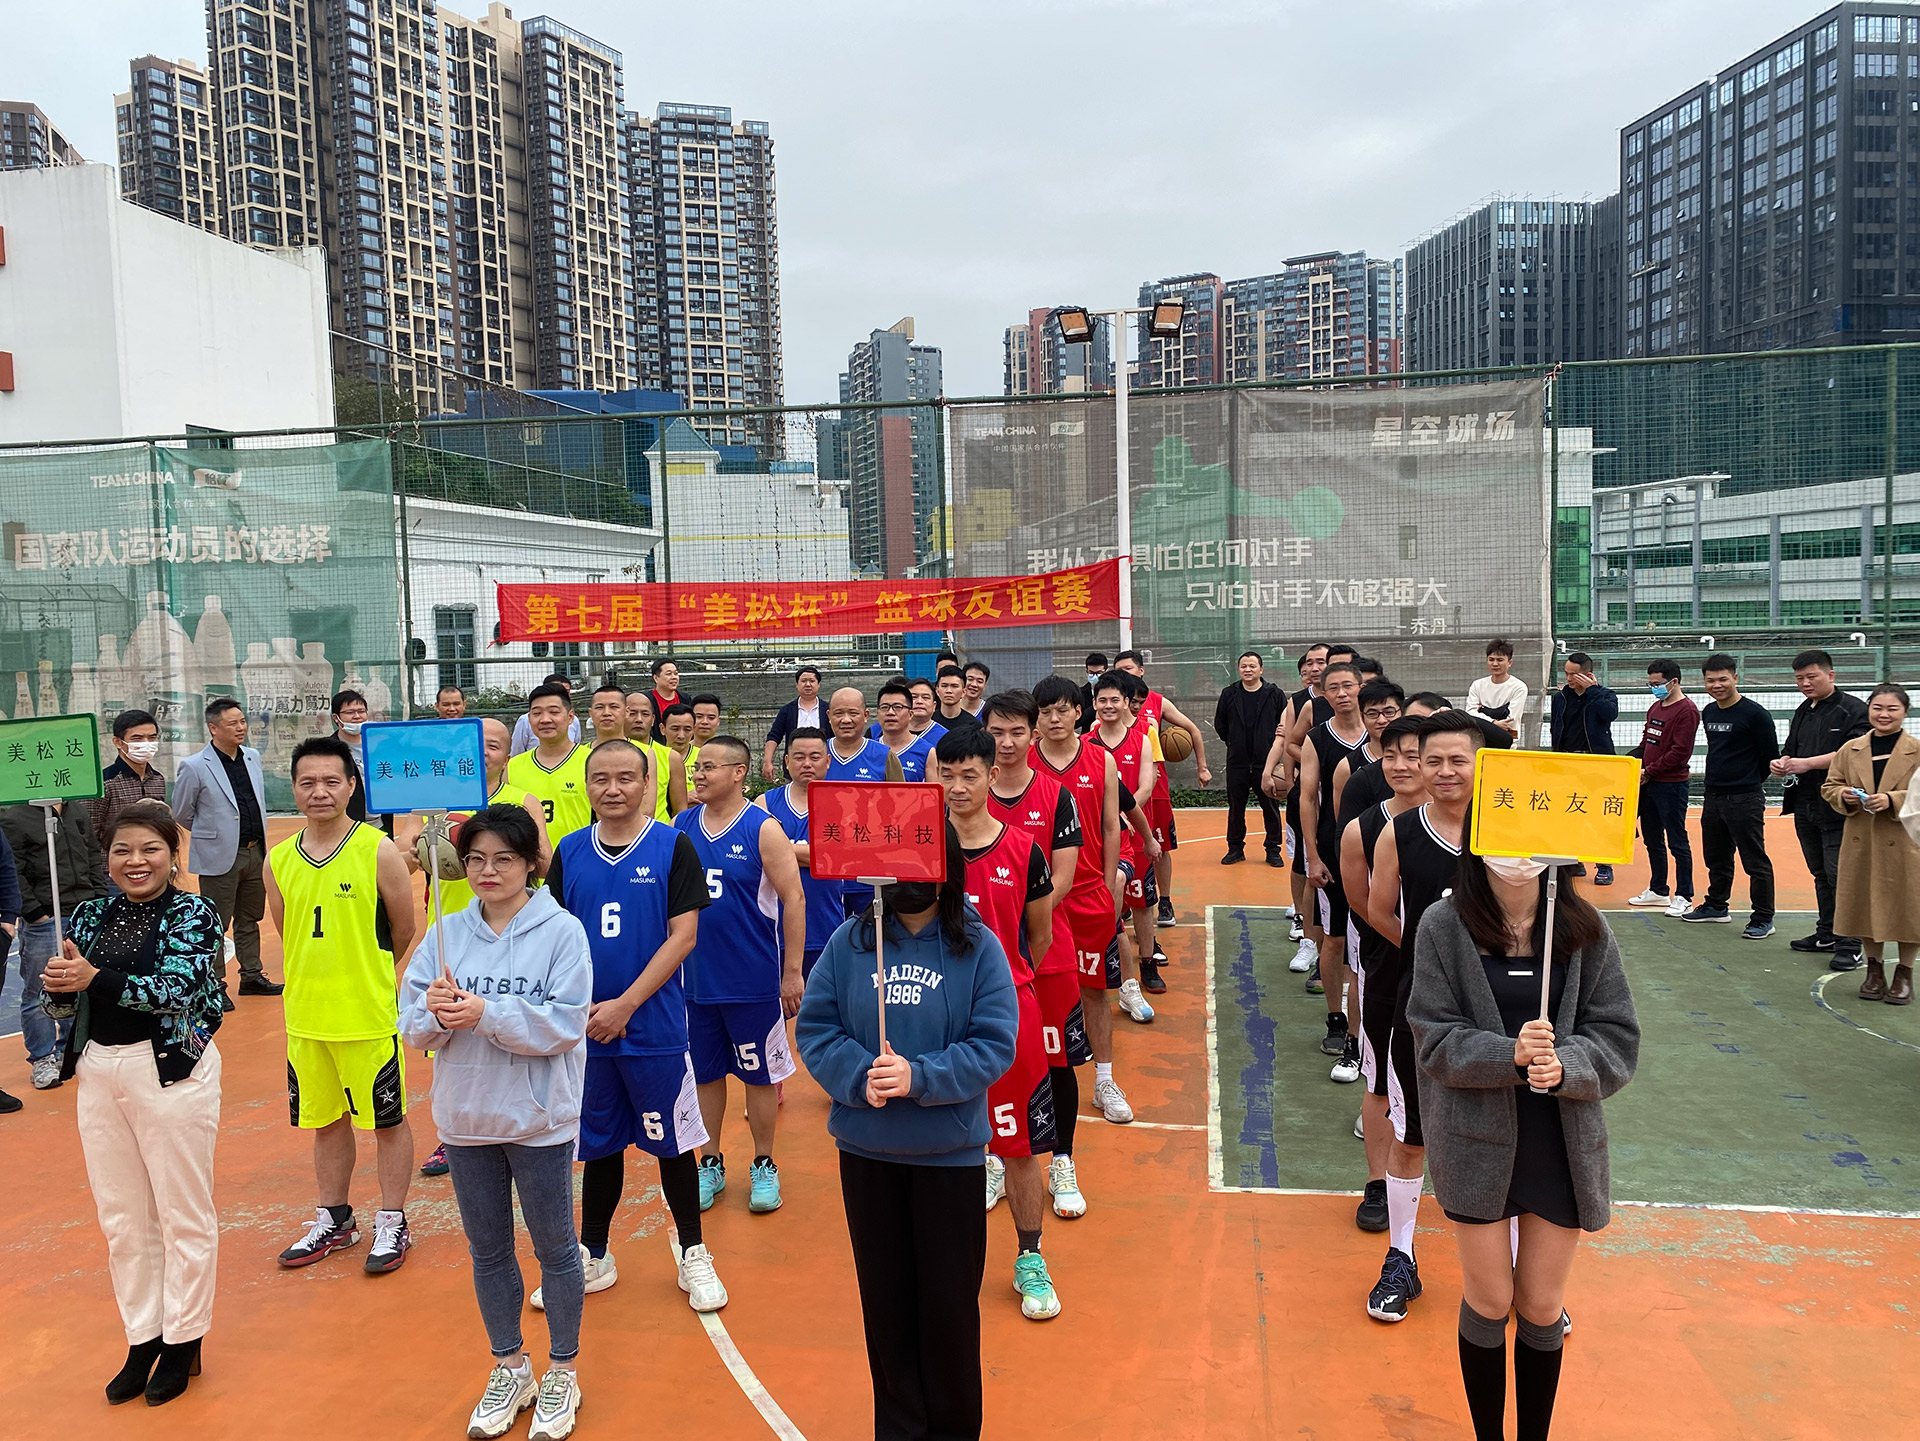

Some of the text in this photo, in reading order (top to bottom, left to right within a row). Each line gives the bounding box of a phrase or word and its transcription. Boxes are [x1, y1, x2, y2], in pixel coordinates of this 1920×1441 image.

[975, 425, 1037, 437] TEAM CHINA
[1372, 410, 1517, 447] 星空球场
[90, 470, 175, 488] TEAM CHINA
[14, 524, 332, 571] 国家队运动员的选择
[524, 593, 645, 635] 第七届
[874, 571, 1094, 625] 篮球友谊赛
[1186, 578, 1448, 611] 只怕对手不够强大
[275, 695, 304, 714] 魔力
[305, 694, 331, 711] 魔力
[8, 738, 85, 763] 美松达
[25, 768, 73, 788] 立派
[375, 758, 476, 780] 美松智能
[1492, 787, 1625, 817] 美松友商
[822, 822, 935, 845] 美松科技
[1024, 819, 1046, 827] MASUNG
[725, 852, 748, 861] MASUNG
[629, 876, 656, 884] MASUNG
[703, 868, 724, 899] 5
[989, 875, 1015, 887] MASUNG
[333, 891, 357, 900] MASUNG
[311, 905, 324, 938] 1
[600, 901, 621, 939] 6
[1077, 949, 1101, 976] 17
[455, 974, 544, 999] MIBIA
[871, 963, 944, 991] MADEIN
[885, 984, 923, 1006] 1986
[344, 1087, 359, 1116] 1
[641, 1111, 665, 1142] 6
[993, 1102, 1018, 1137] 5
